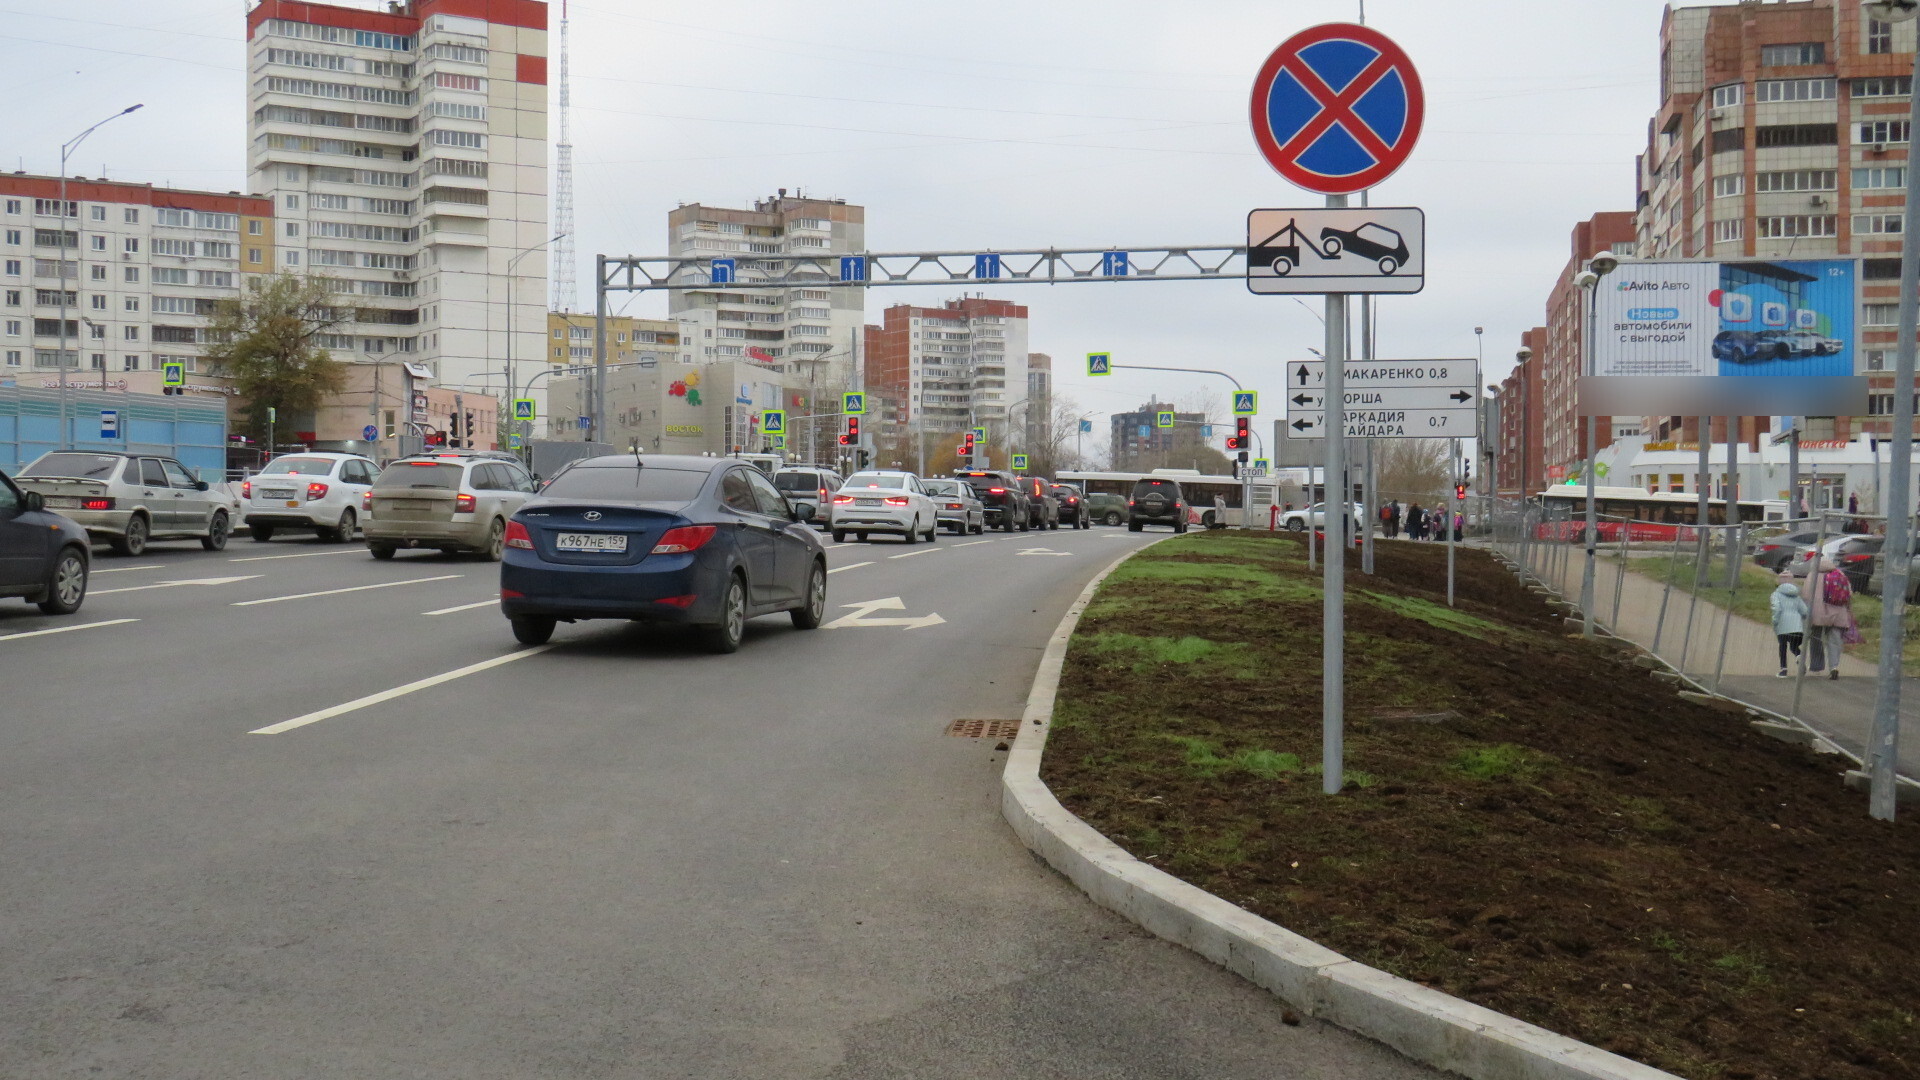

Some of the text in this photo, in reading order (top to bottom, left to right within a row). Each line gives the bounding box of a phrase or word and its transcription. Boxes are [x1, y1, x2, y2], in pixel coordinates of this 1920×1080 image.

[1828, 268, 1845, 276] 12+
[1629, 280, 1690, 291] Avito Авто
[1631, 309, 1675, 319] Новые
[1613, 320, 1692, 331] автомобили
[1620, 331, 1686, 343] с выгодой
[1344, 368, 1424, 379] МАКАРЕНКО
[1429, 368, 1447, 380] 0,8
[1344, 411, 1405, 423] АРКАДИЯ
[1429, 416, 1447, 428] 0,7
[666, 424, 703, 433] ВОСТОК
[1239, 429, 1247, 437] 20
[1241, 468, 1263, 476] СТОП
[561, 535, 625, 548] К967НЕ 159
